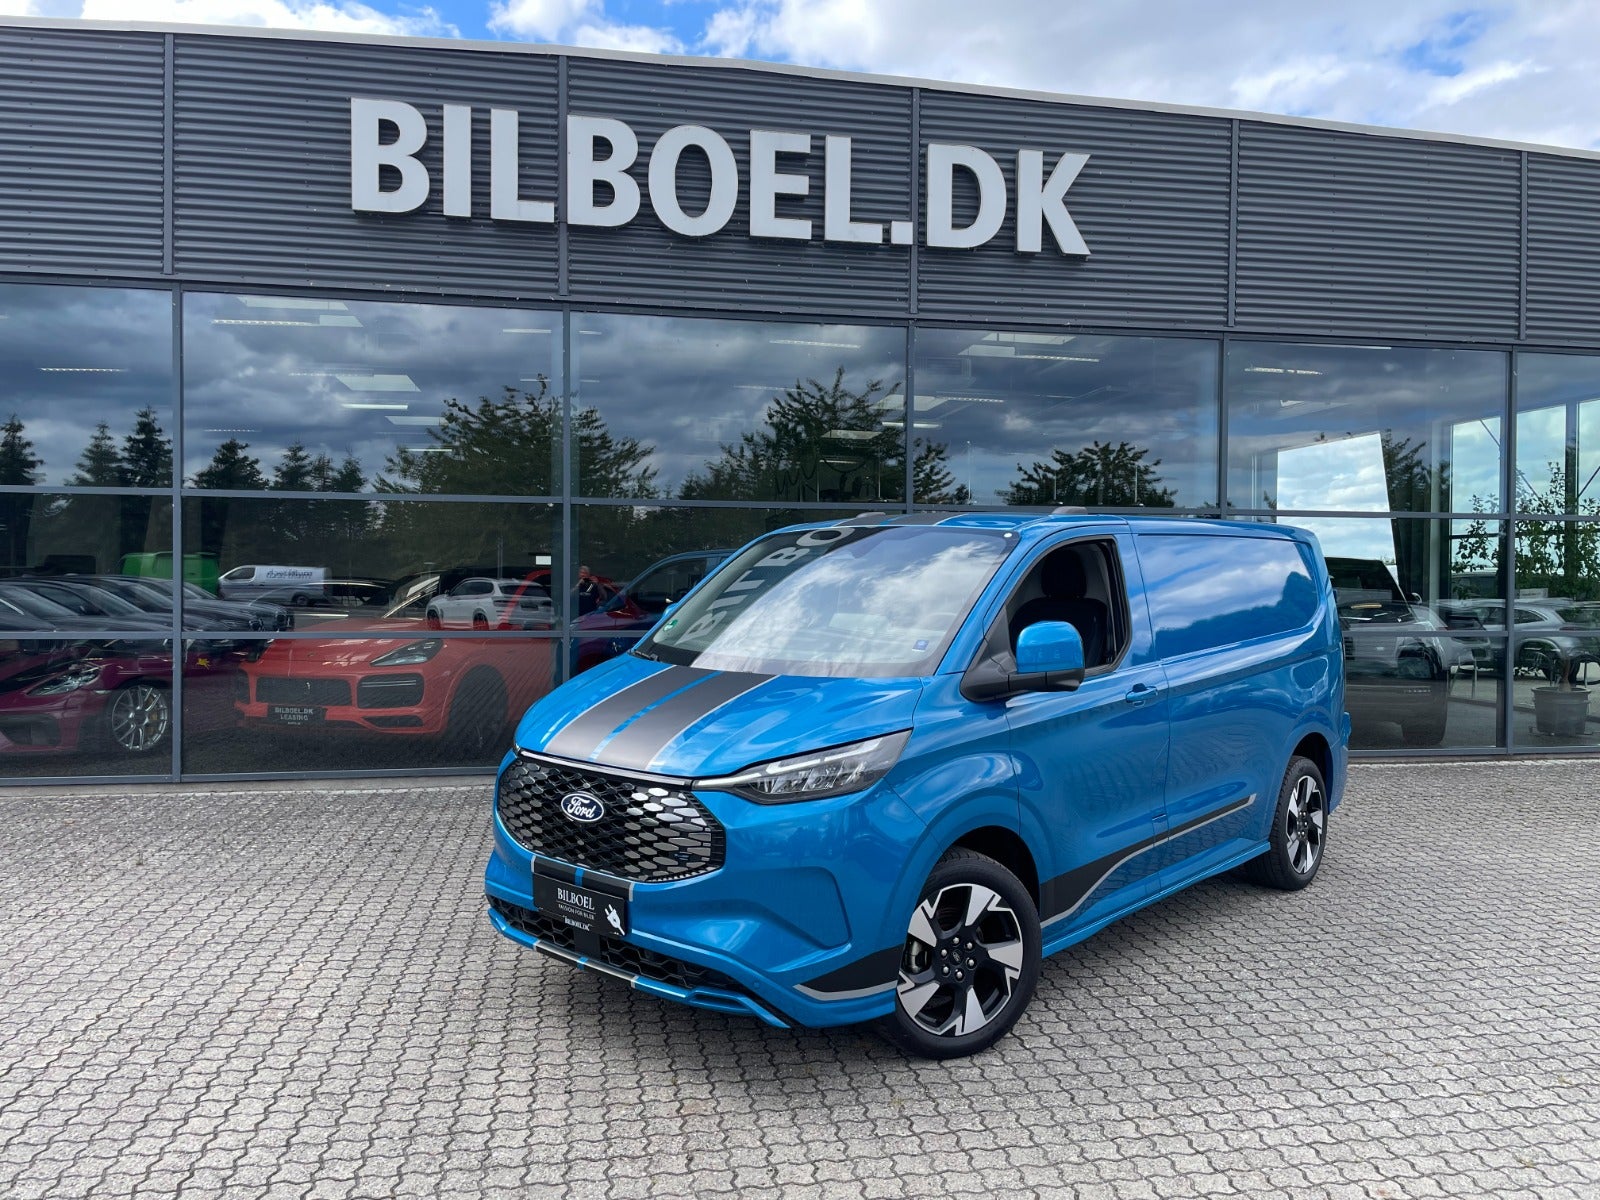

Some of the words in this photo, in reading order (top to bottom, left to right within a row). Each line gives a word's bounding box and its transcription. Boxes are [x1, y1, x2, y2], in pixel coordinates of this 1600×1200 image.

[351, 97, 1092, 256] BILBOEL.DK
[566, 796, 597, 819] Ford
[557, 887, 595, 911] BILBOEL
